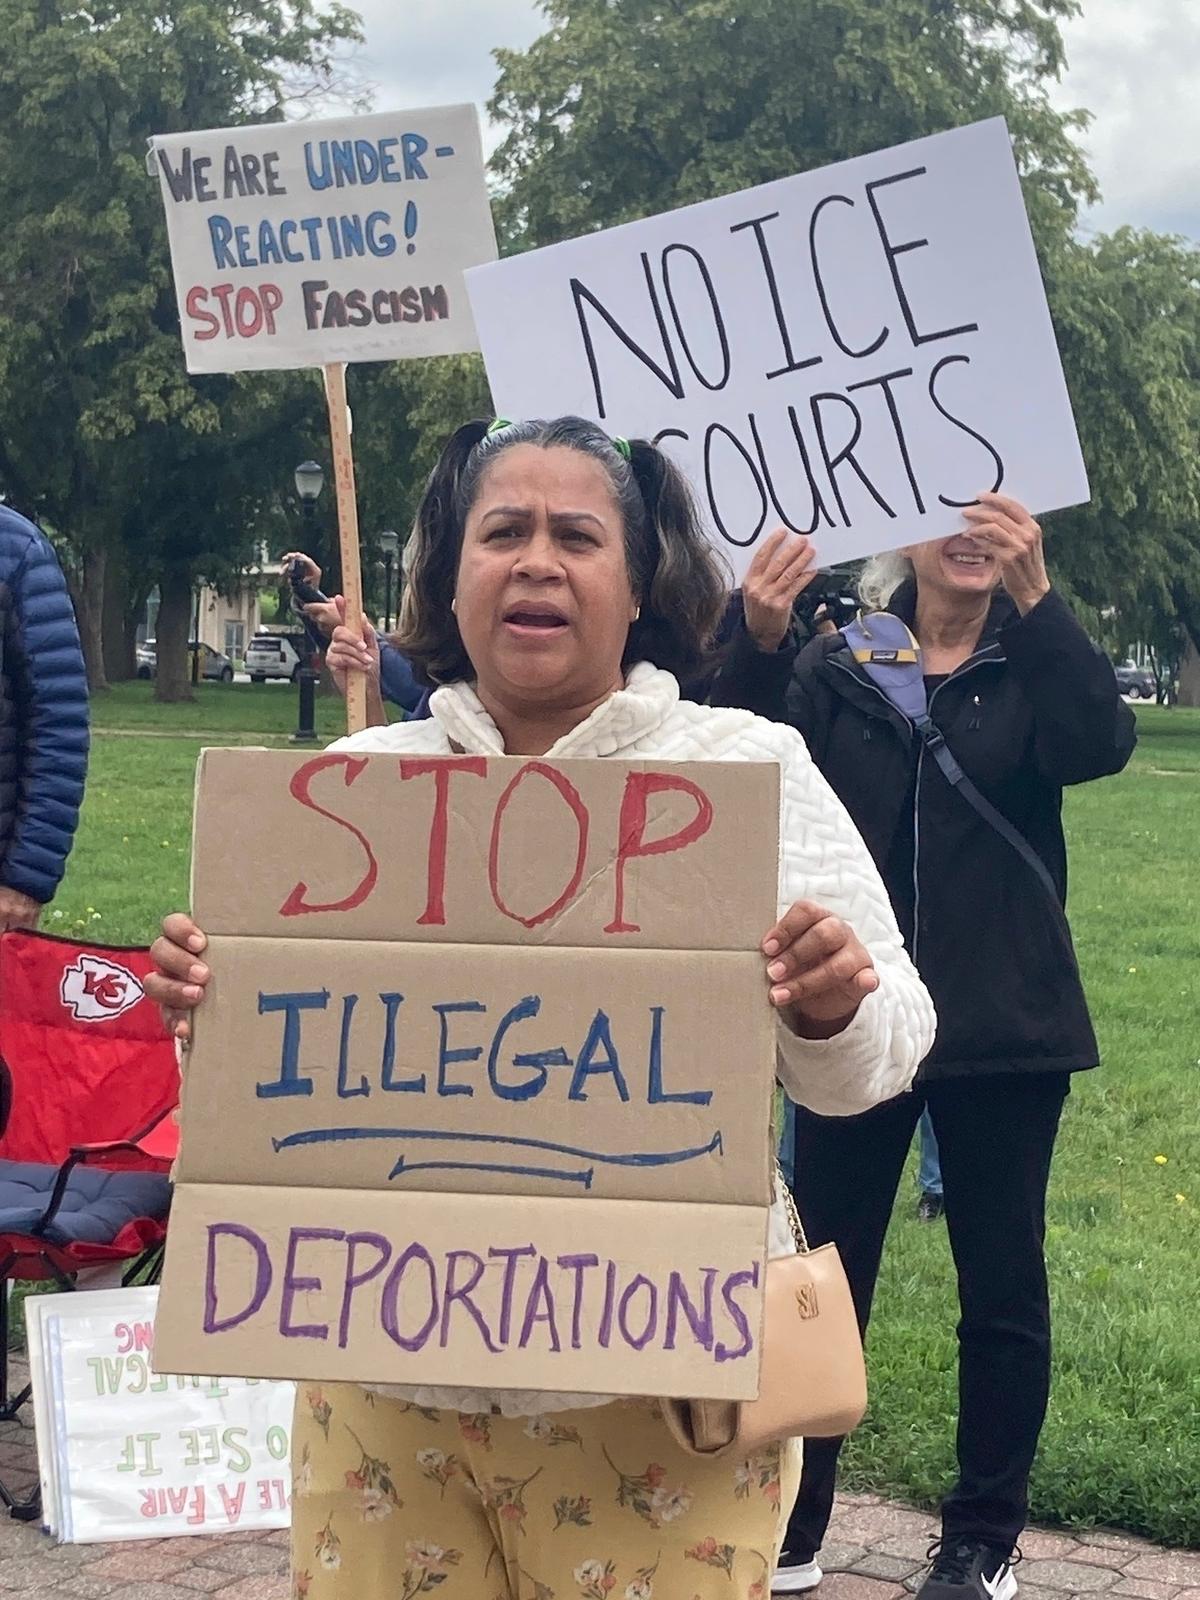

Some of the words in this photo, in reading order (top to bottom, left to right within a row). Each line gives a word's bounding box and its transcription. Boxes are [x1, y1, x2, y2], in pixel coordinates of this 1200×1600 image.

[157, 147, 218, 202] WE
[223, 145, 287, 199] ARE
[303, 133, 455, 191] UNDER-
[207, 200, 418, 269] REACTING!
[186, 283, 283, 340] STOP
[301, 279, 449, 330] FASCISM
[569, 242, 731, 419] NO
[730, 165, 979, 379] ICE
[652, 354, 1004, 547] OURTS
[279, 753, 713, 934] STOP
[82, 970, 127, 1008] KC
[255, 987, 713, 1106] ILLEGAL
[202, 1222, 761, 1362] DEPORTATIONS
[114, 1322, 156, 1353] NG
[86, 1353, 228, 1398] IEGAL
[117, 1432, 163, 1477] IF
[179, 1425, 251, 1474] SEE
[266, 1425, 289, 1460] O
[138, 1486, 206, 1525] FAIR
[217, 1481, 247, 1524] A
[257, 1480, 293, 1510] LE
